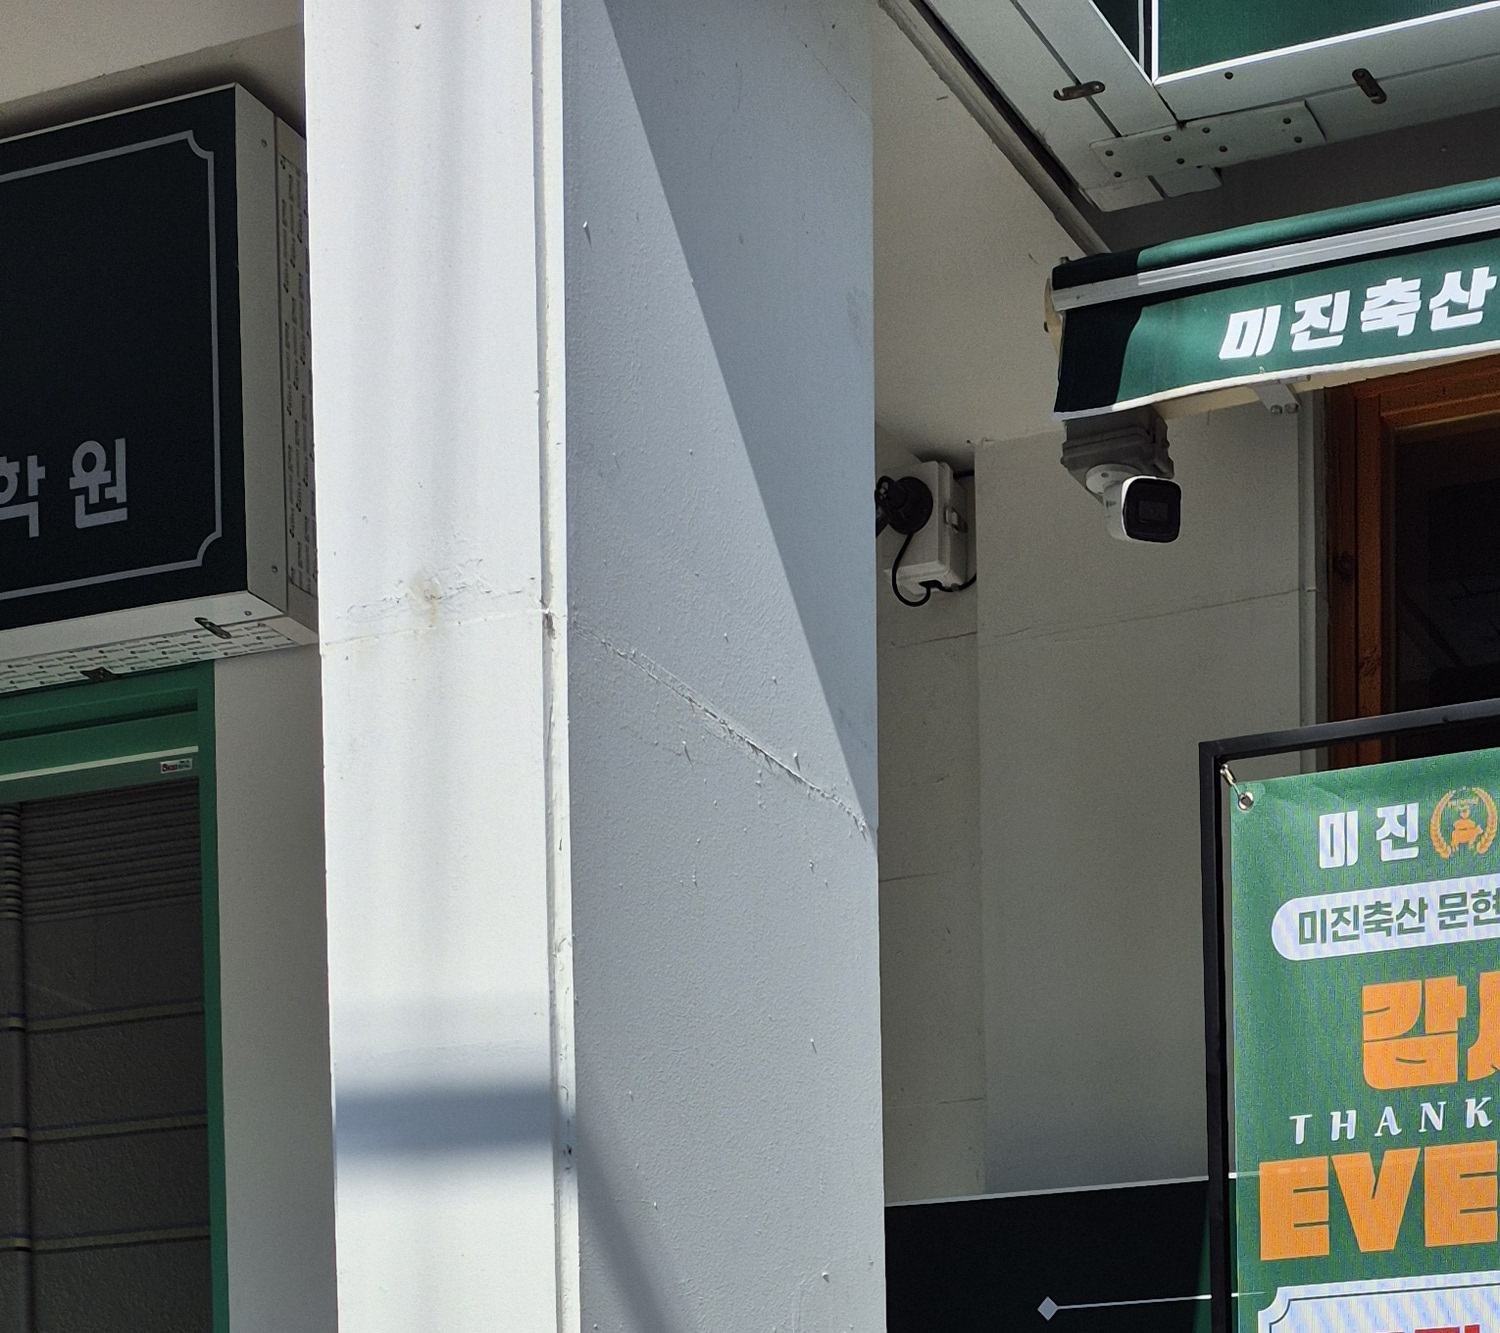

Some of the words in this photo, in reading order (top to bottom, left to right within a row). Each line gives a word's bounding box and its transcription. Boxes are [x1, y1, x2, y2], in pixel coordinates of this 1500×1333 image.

[1218, 267, 1497, 360] 미진축산
[1299, 896, 1428, 945] 미진축산
[1289, 1097, 1493, 1145] THANK
